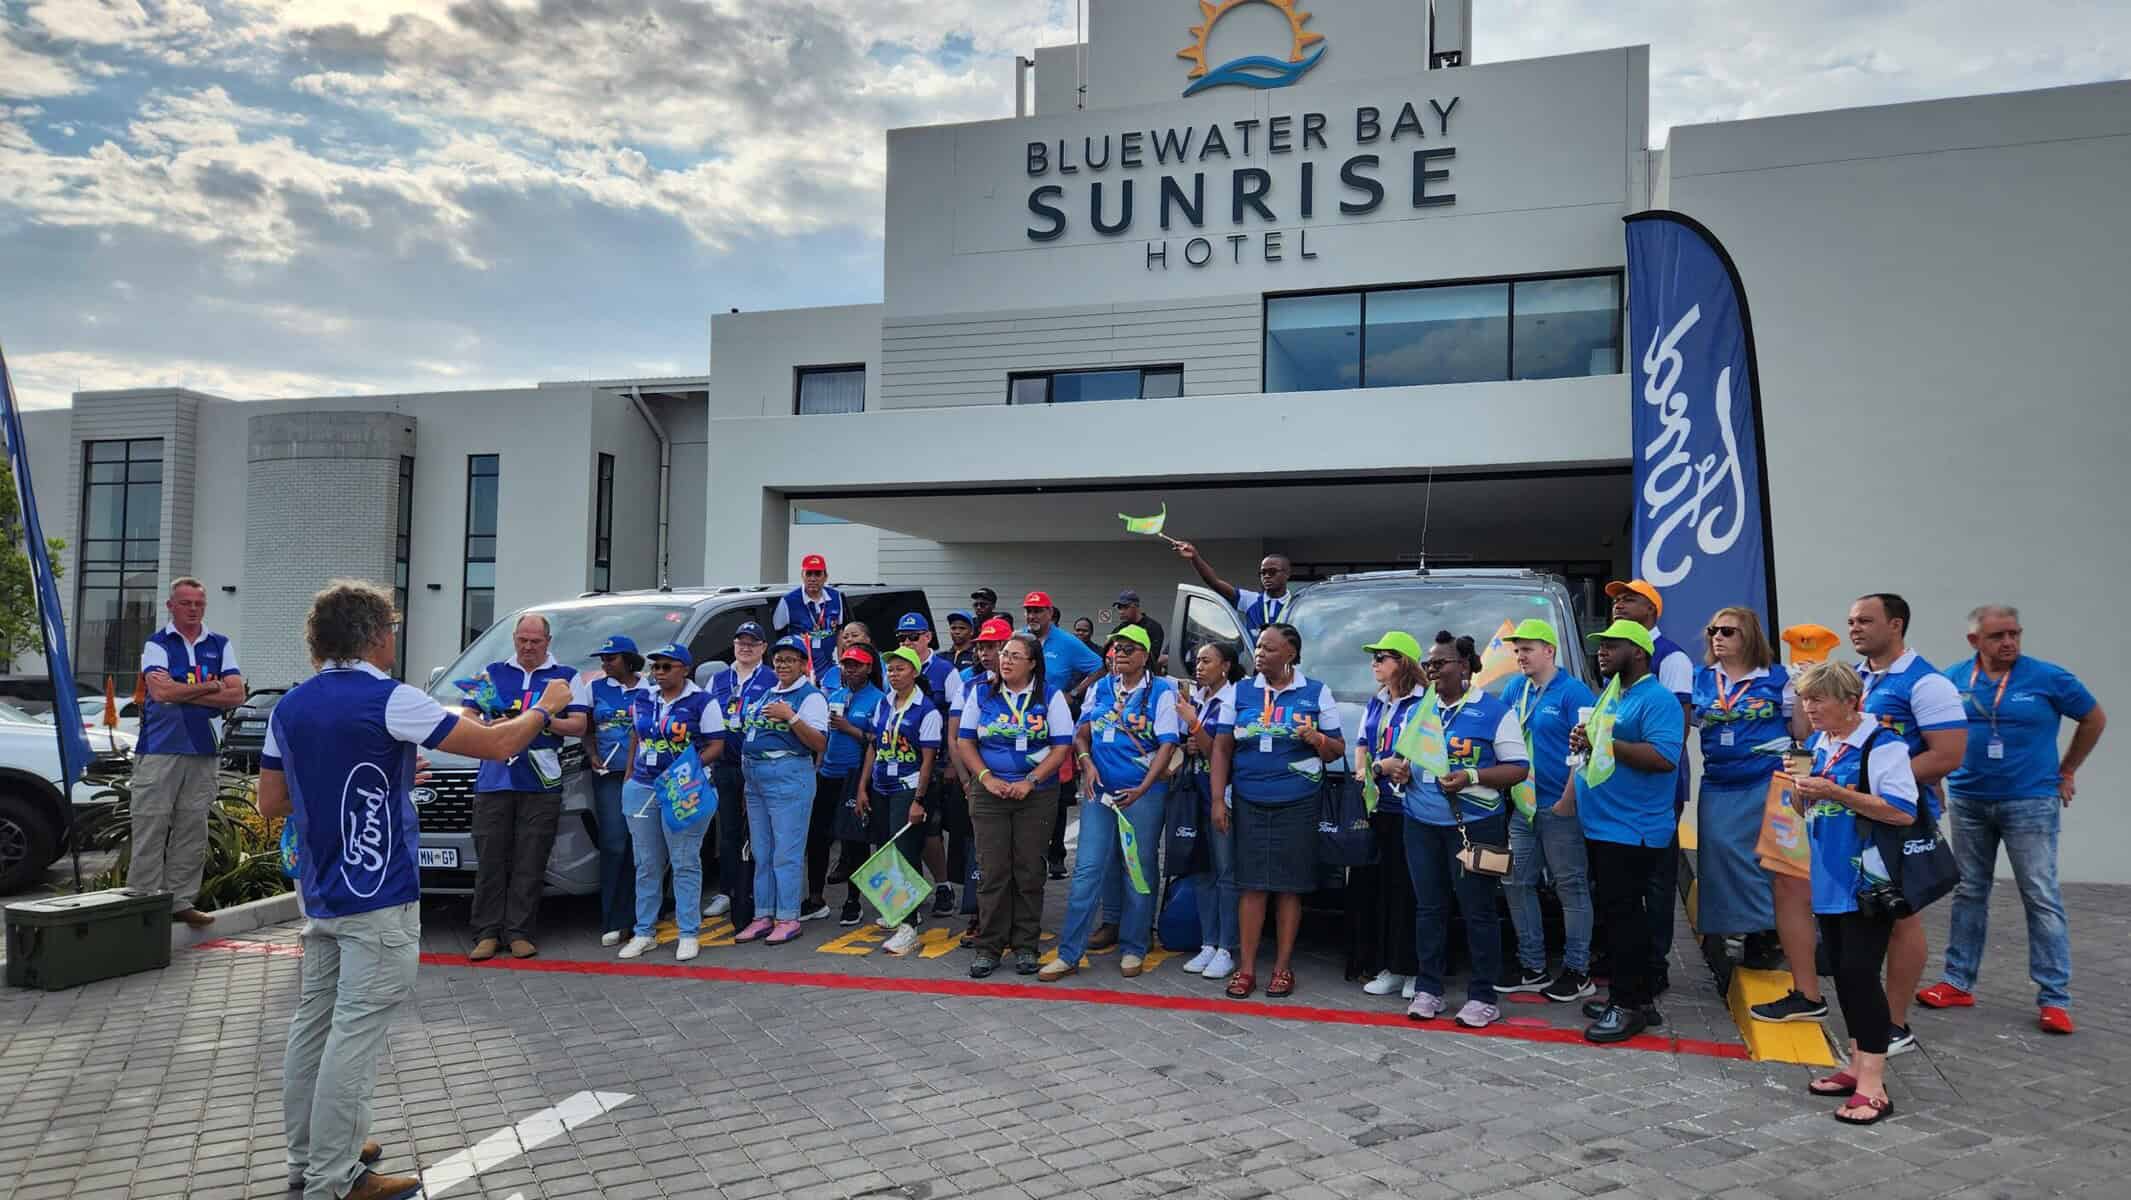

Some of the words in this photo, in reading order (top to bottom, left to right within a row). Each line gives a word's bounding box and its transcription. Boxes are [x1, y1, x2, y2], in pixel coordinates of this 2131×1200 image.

[1026, 112, 1328, 177] BLUEWATER
[1355, 96, 1460, 144] BAY
[1026, 146, 1458, 242] SUNRISE
[1145, 229, 1319, 271] HOTEL
[1641, 303, 1745, 588] Ford
[343, 786, 387, 873] Ford
[1903, 838, 1937, 856] Ford
